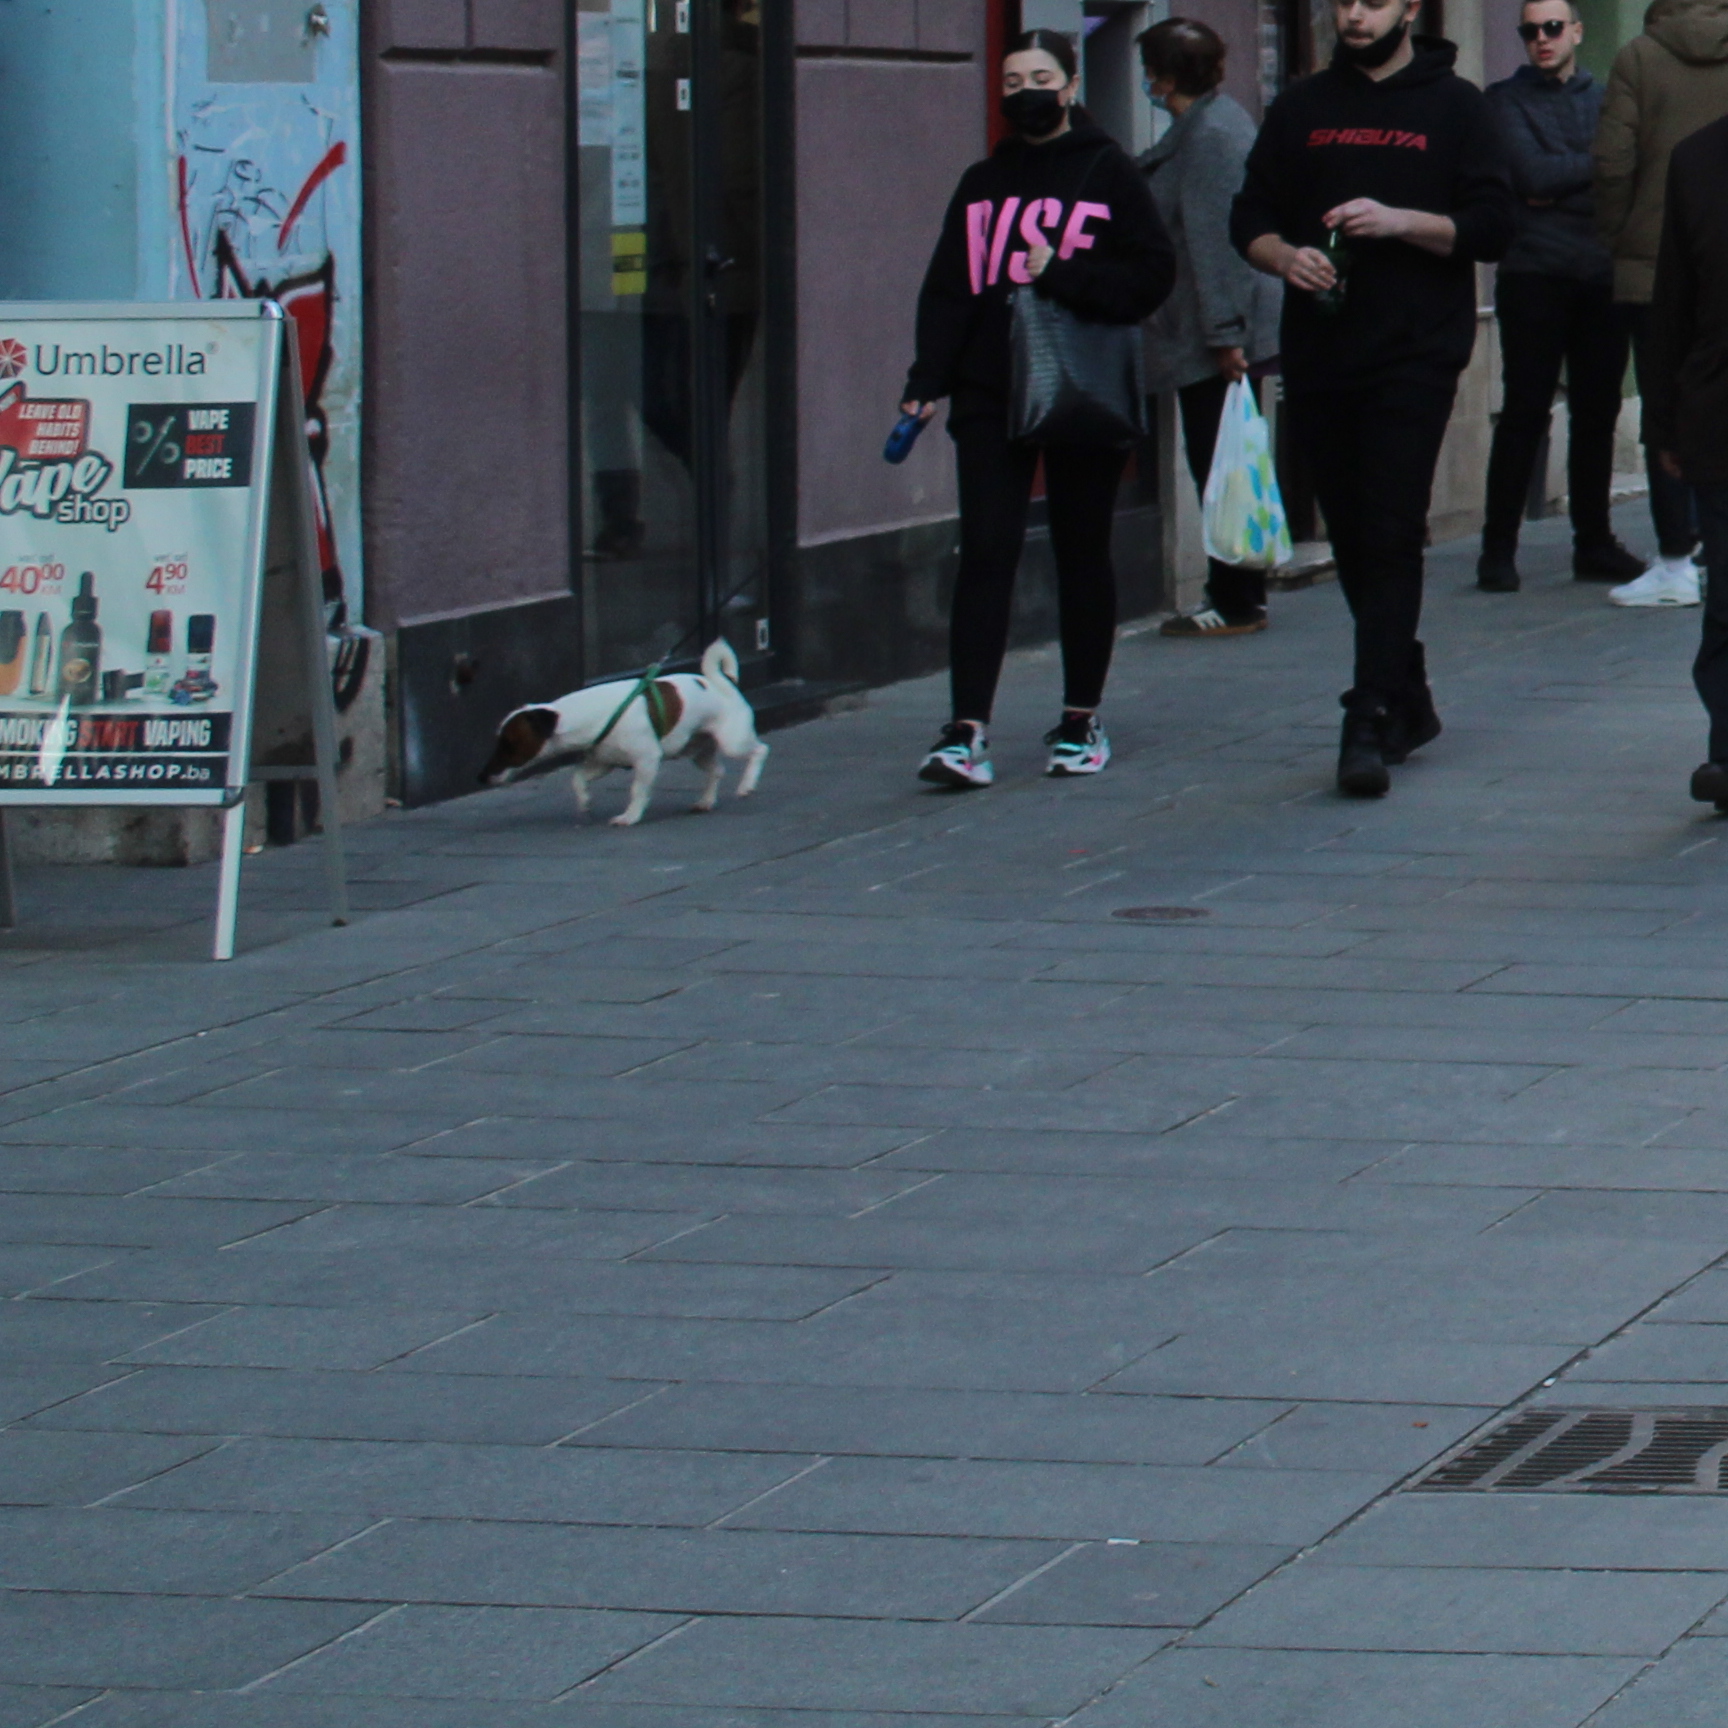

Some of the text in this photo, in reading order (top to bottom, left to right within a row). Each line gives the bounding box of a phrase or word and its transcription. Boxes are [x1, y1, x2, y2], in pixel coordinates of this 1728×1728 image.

[1305, 127, 1428, 151] SHIBUYA
[35, 344, 207, 376] Umbrella
[18, 404, 82, 420] LEAVE OLD
[187, 409, 230, 431] VAPE
[36, 421, 80, 437] HABITS
[28, 439, 80, 455] BEHIND!
[184, 434, 226, 454] BEST
[183, 457, 232, 480] PRICE
[58, 493, 128, 531] shop
[79, 720, 139, 747] START
[144, 718, 212, 747] VAPING
